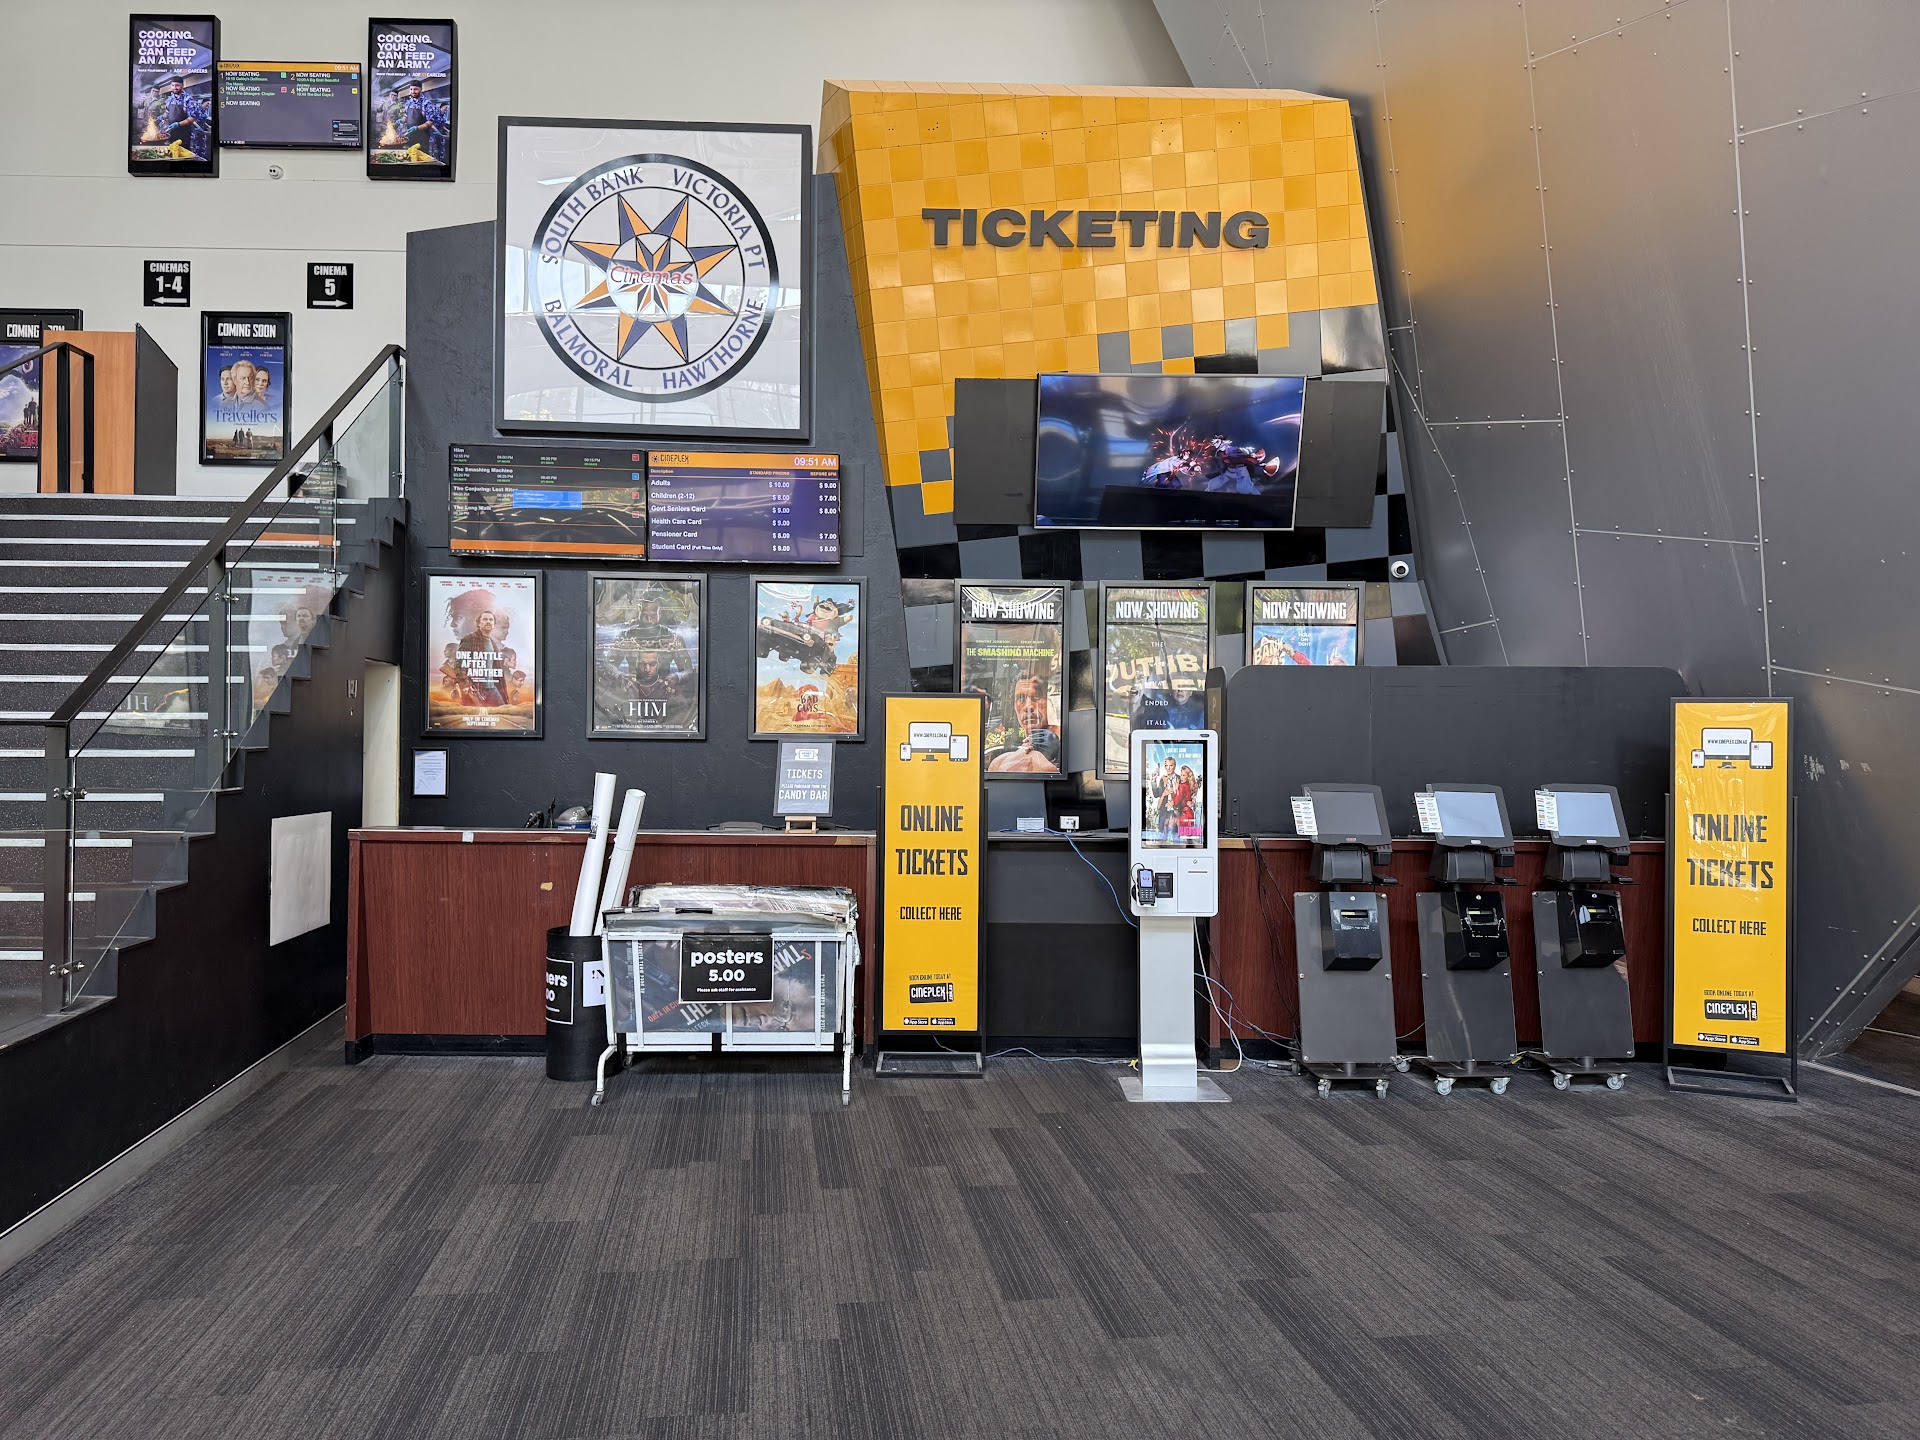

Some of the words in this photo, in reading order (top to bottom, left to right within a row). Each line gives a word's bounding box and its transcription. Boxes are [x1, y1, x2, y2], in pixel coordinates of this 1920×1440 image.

[138, 30, 194, 40] COOKING.
[377, 34, 433, 43] COOKING.
[139, 39, 178, 48] YOURS
[377, 43, 416, 52] YOURS
[138, 48, 164, 56] CAN
[167, 48, 197, 56] FEED
[377, 52, 402, 60] CAN
[406, 52, 435, 60] FEED
[139, 56, 156, 64] AN
[158, 57, 192, 65] ARMY.
[377, 60, 394, 68] AN
[397, 61, 431, 69] ARMY.
[542, 196, 587, 265] SOUTH
[586, 167, 644, 202] BANK
[673, 168, 752, 241] VICTORIA
[744, 244, 765, 270] PT
[922, 208, 1270, 249] TICKETING
[150, 263, 189, 273] CINEMAS
[314, 265, 347, 276] CINEMA
[610, 266, 693, 285] Cinemas
[156, 276, 183, 293] 1-4
[325, 278, 336, 296] 5
[7, 324, 40, 338] COMING
[218, 323, 251, 337] COMING
[253, 324, 276, 338] SOON
[545, 299, 633, 388] BALMORAL
[662, 299, 764, 390] HAWTHORNE
[214, 410, 277, 423] Travellers
[794, 458, 819, 466] 09:51
[821, 458, 836, 466] AM
[972, 601, 997, 618] NOW
[1001, 602, 1054, 619] SHOWING
[1116, 602, 1142, 618] NOW
[1147, 601, 1199, 619] SHOWING
[1263, 602, 1290, 619] NOW
[1294, 603, 1347, 620] SHOWING
[456, 651, 472, 660] ONE
[473, 652, 503, 660] BATTLE
[967, 648, 976, 656] THE
[978, 648, 1022, 656] SMASHING
[461, 660, 486, 668] AFTER
[467, 668, 503, 677] ANOTHER
[802, 695, 818, 704] BAD
[629, 702, 666, 717] HIM
[797, 704, 818, 713] GUYS
[787, 769, 823, 779] TICKETS
[779, 790, 807, 800] CANDY
[810, 790, 828, 800] BAR
[901, 806, 964, 832] ONLINE
[1693, 814, 1767, 842] ONLINE
[896, 849, 968, 876] TICKETS
[1687, 859, 1774, 889] TICKETS
[900, 907, 937, 920] COLLECT
[940, 907, 962, 920] HERE
[1693, 918, 1736, 934] COLLECT
[1740, 921, 1766, 936] HERE
[691, 950, 764, 967] posters
[709, 969, 745, 982] 5.00
[911, 986, 946, 1000] CINEPLEX
[1707, 1003, 1748, 1018] CINEPLEX
